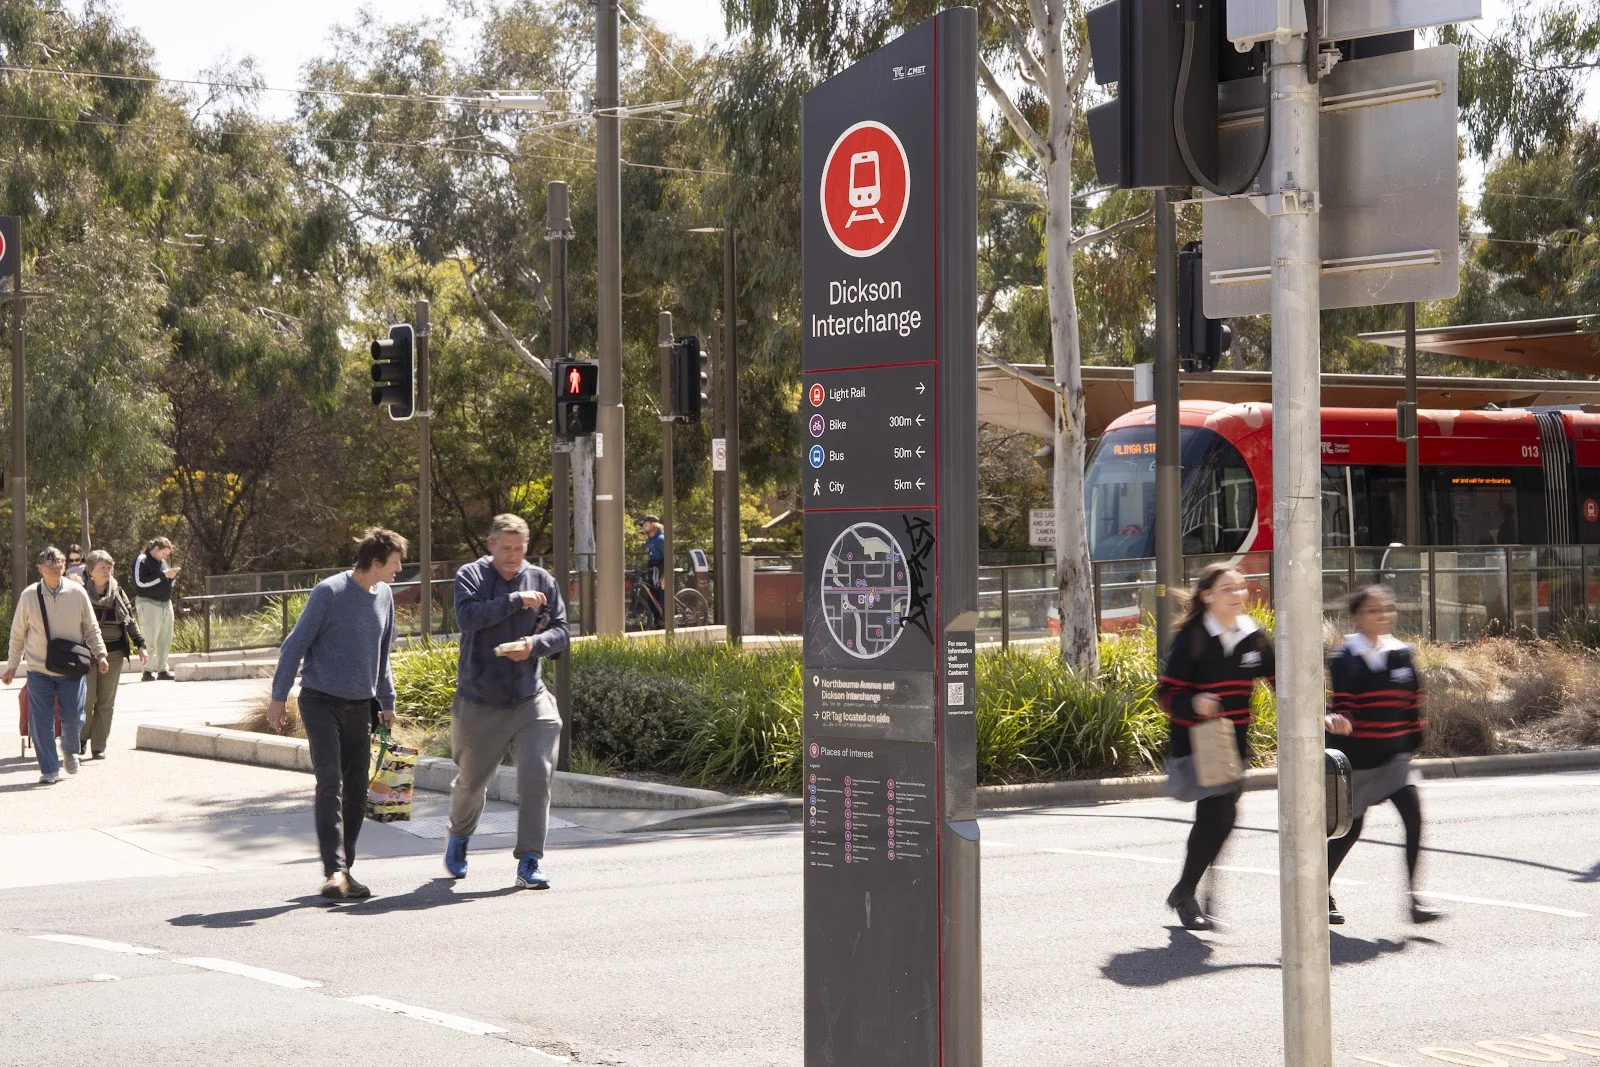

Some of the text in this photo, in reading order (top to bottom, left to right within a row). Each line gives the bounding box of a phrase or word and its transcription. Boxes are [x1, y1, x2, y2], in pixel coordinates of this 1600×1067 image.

[829, 278, 902, 305] Dickson
[812, 308, 922, 338] Interchange
[829, 387, 866, 402] Light Rail
[829, 415, 912, 430] Bike 300m
[829, 447, 912, 461] Bus 50m
[1114, 443, 1157, 455] ALINGA STR
[1521, 445, 1539, 457] 013
[829, 478, 912, 494] City 5km
[821, 679, 895, 690] Northbourne Avenue and
[821, 690, 881, 703] Dickson Interchange
[821, 710, 890, 724] QR Tag located on side
[820, 746, 874, 758] Places of Interest
